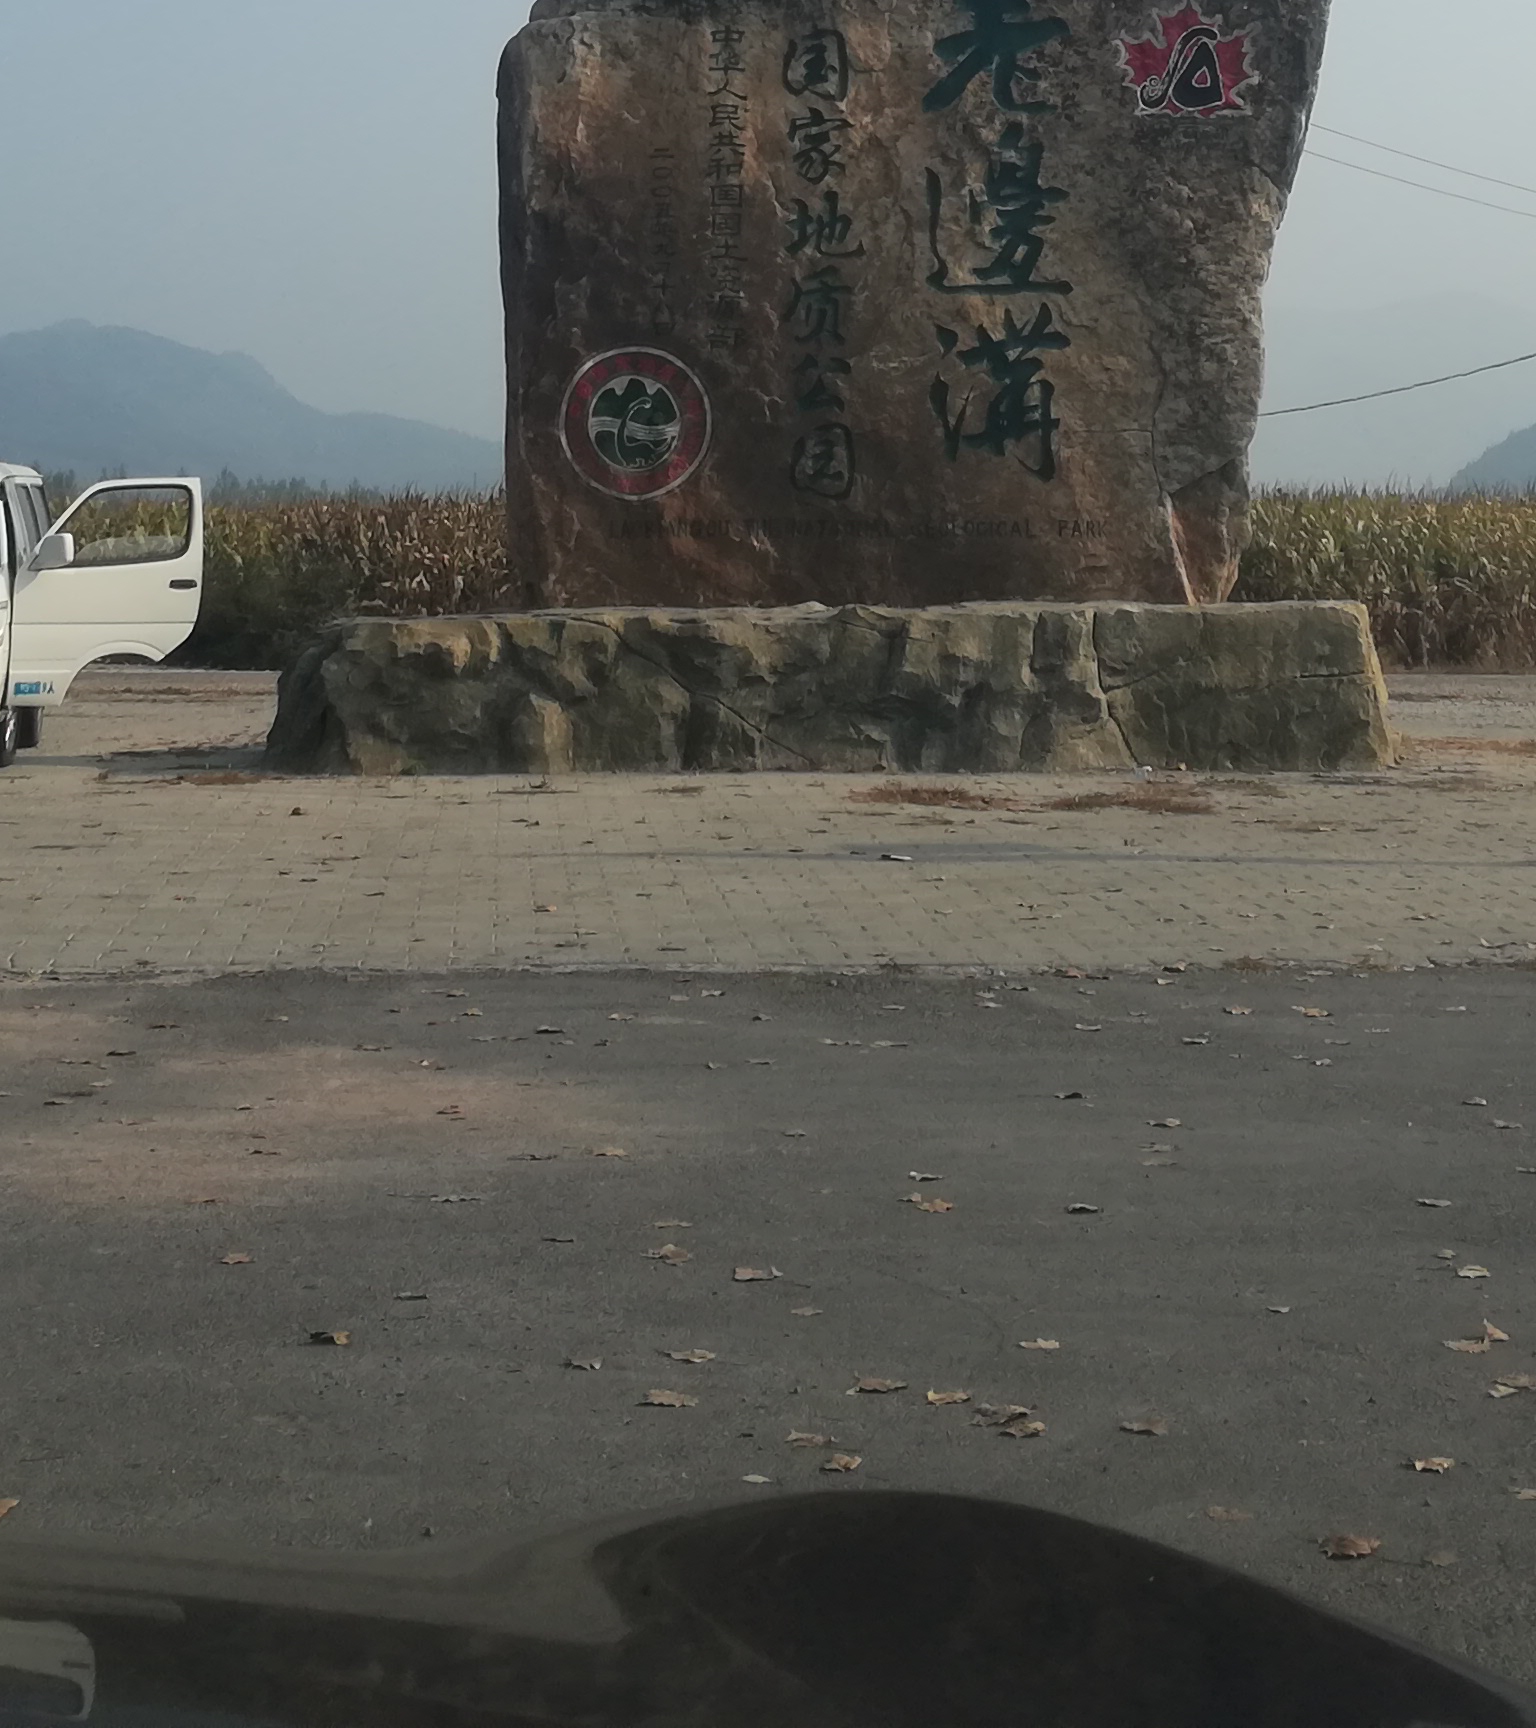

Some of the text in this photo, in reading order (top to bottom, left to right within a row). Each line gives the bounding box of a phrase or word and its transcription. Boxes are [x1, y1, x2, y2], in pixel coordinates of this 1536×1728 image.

[781, 24, 866, 501] 国家地质公园
[1057, 519, 1109, 539] PARK
